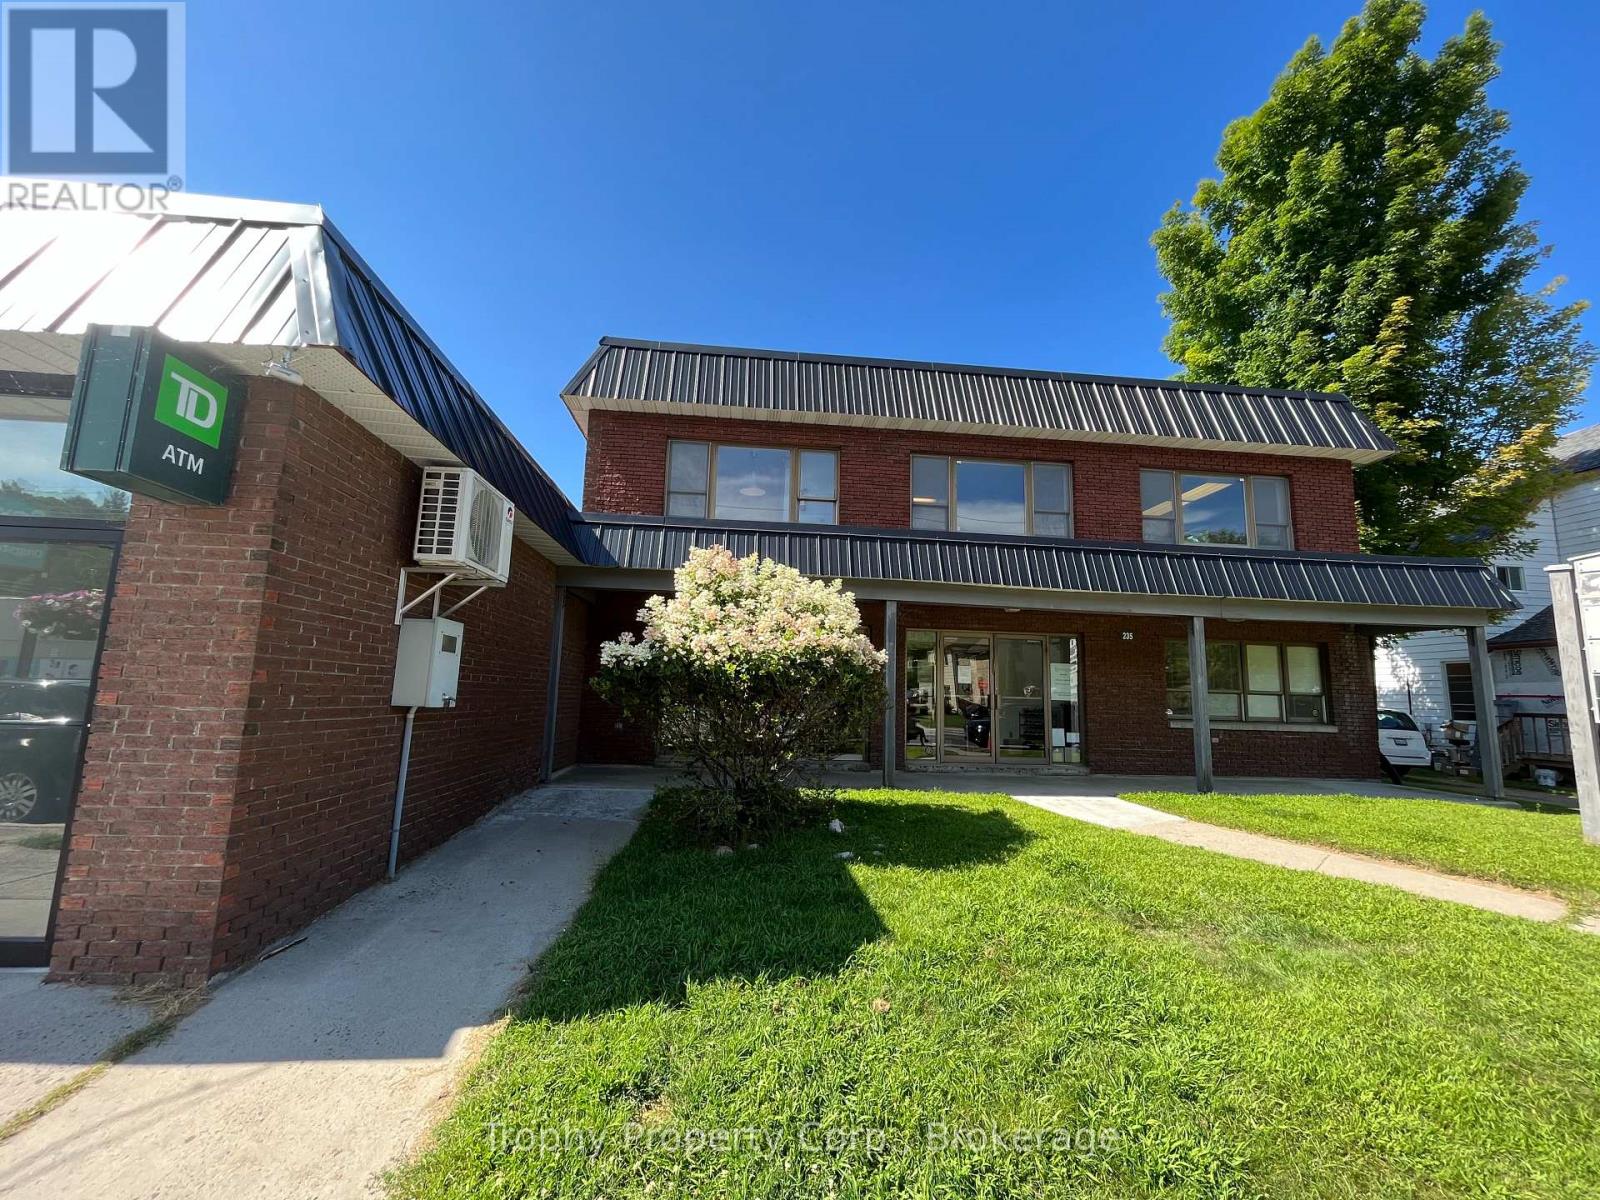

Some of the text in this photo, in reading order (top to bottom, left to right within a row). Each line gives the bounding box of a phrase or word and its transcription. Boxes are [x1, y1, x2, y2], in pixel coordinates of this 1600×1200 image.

[170, 371, 218, 429] TD
[161, 444, 204, 475] ATM
[1122, 632, 1134, 640] 235
